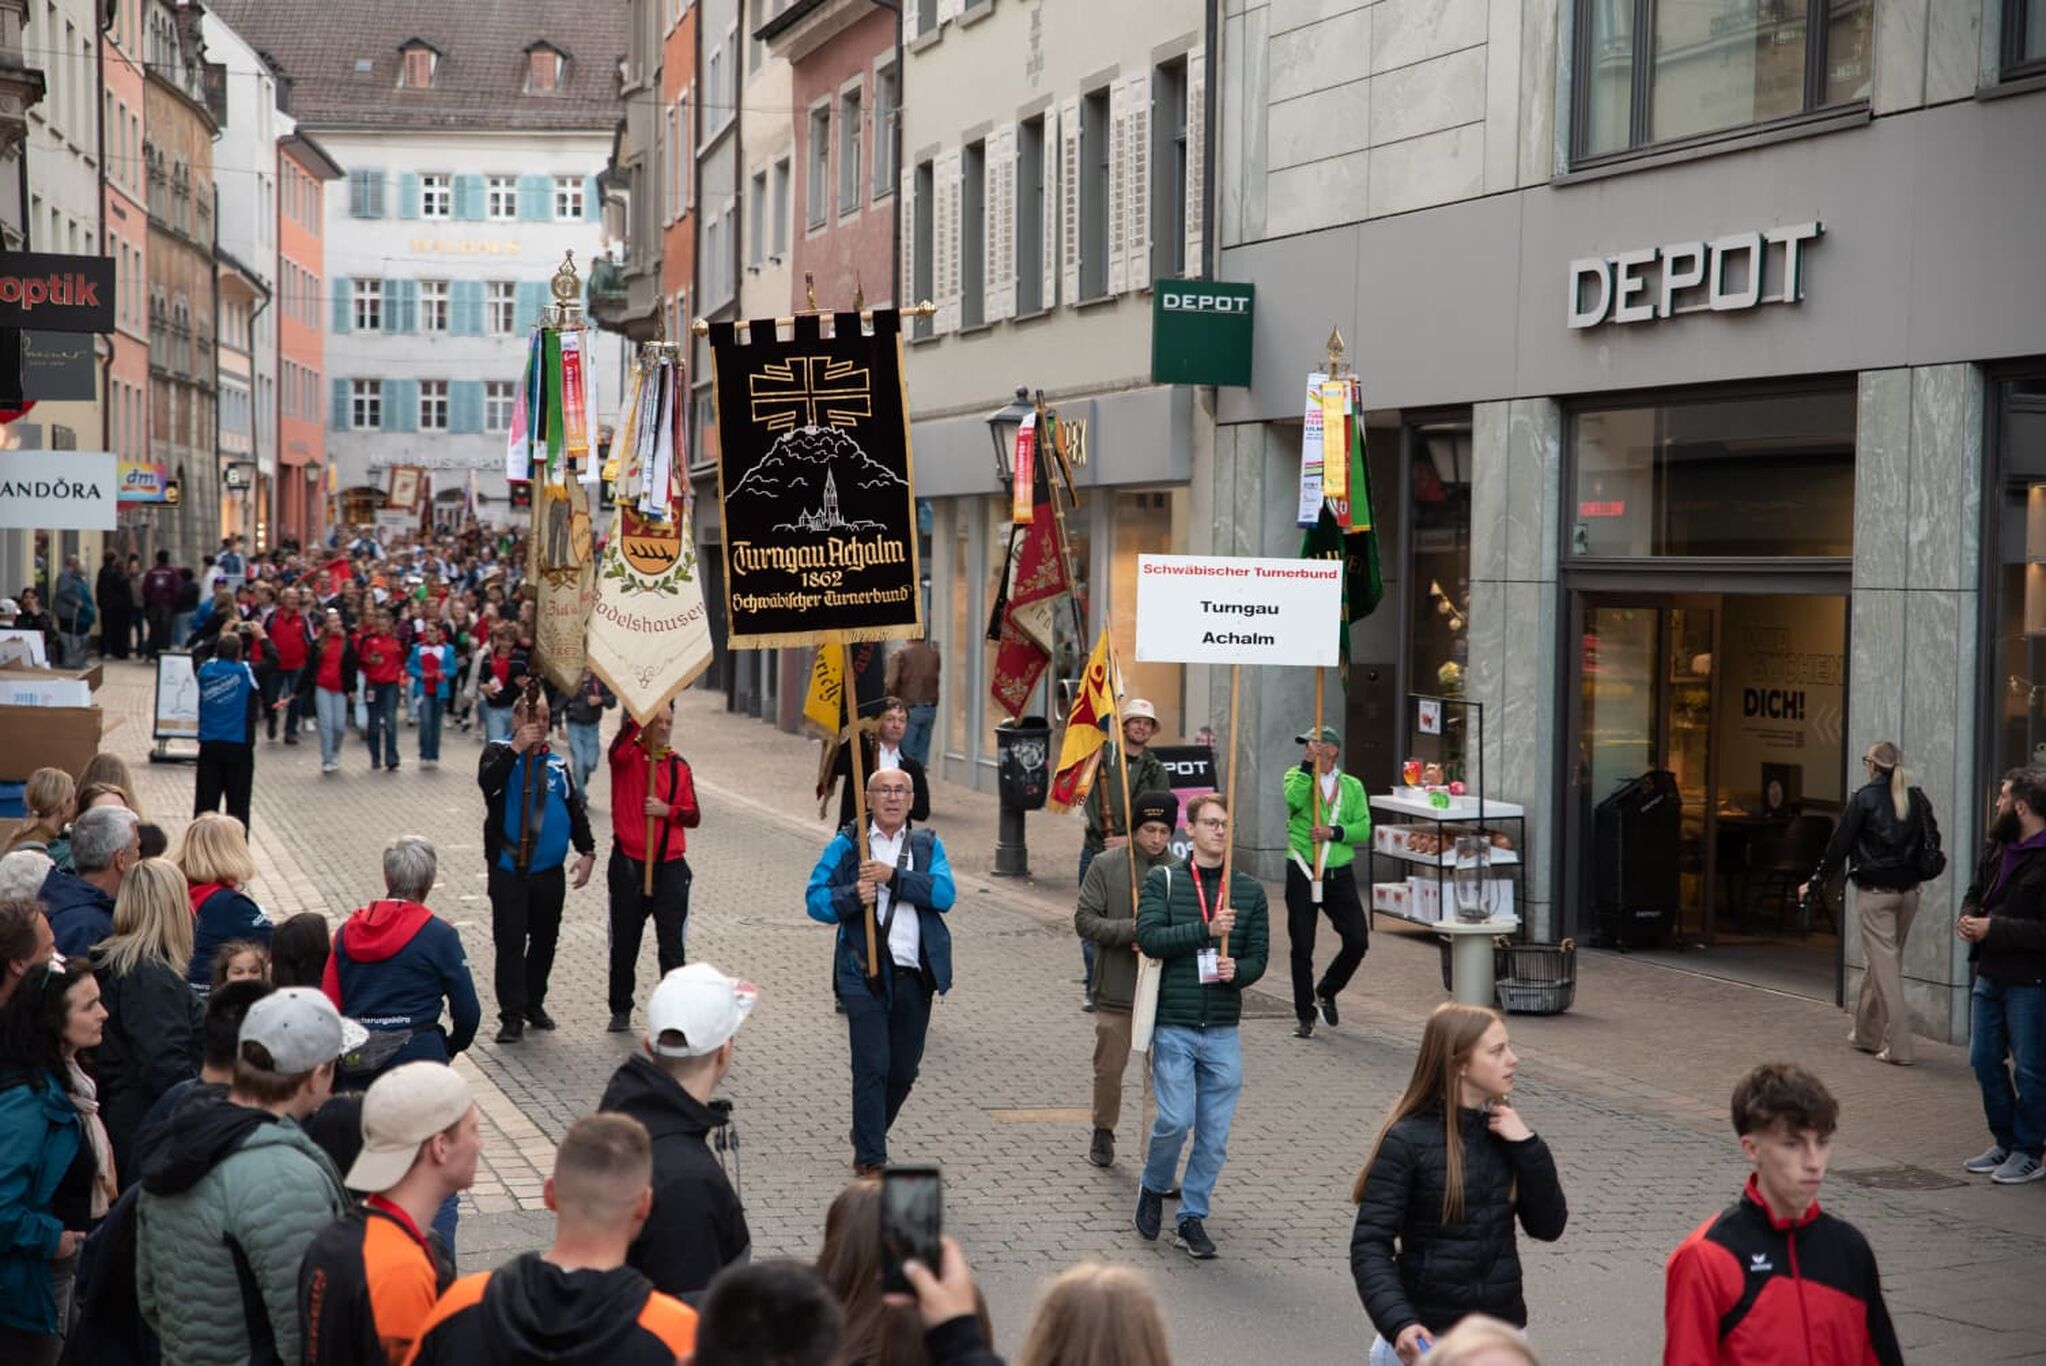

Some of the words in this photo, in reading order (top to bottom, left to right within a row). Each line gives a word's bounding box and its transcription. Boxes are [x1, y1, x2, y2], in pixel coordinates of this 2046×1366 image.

[1567, 221, 1825, 329] DEPOT
[0, 272, 100, 311] optik
[1163, 293, 1249, 311] DEPOT
[126, 469, 156, 484] dm
[732, 541, 825, 576] Turngau
[827, 534, 906, 572] Achalm
[800, 571, 844, 588] 1862
[1144, 563, 1250, 578] Schwäbischer
[1254, 566, 1338, 580] Turnerbund
[823, 585, 912, 606] Turnerbund
[1200, 600, 1280, 617] Turngau
[1202, 631, 1275, 646] Achalm
[1743, 688, 1806, 721] DICH!
